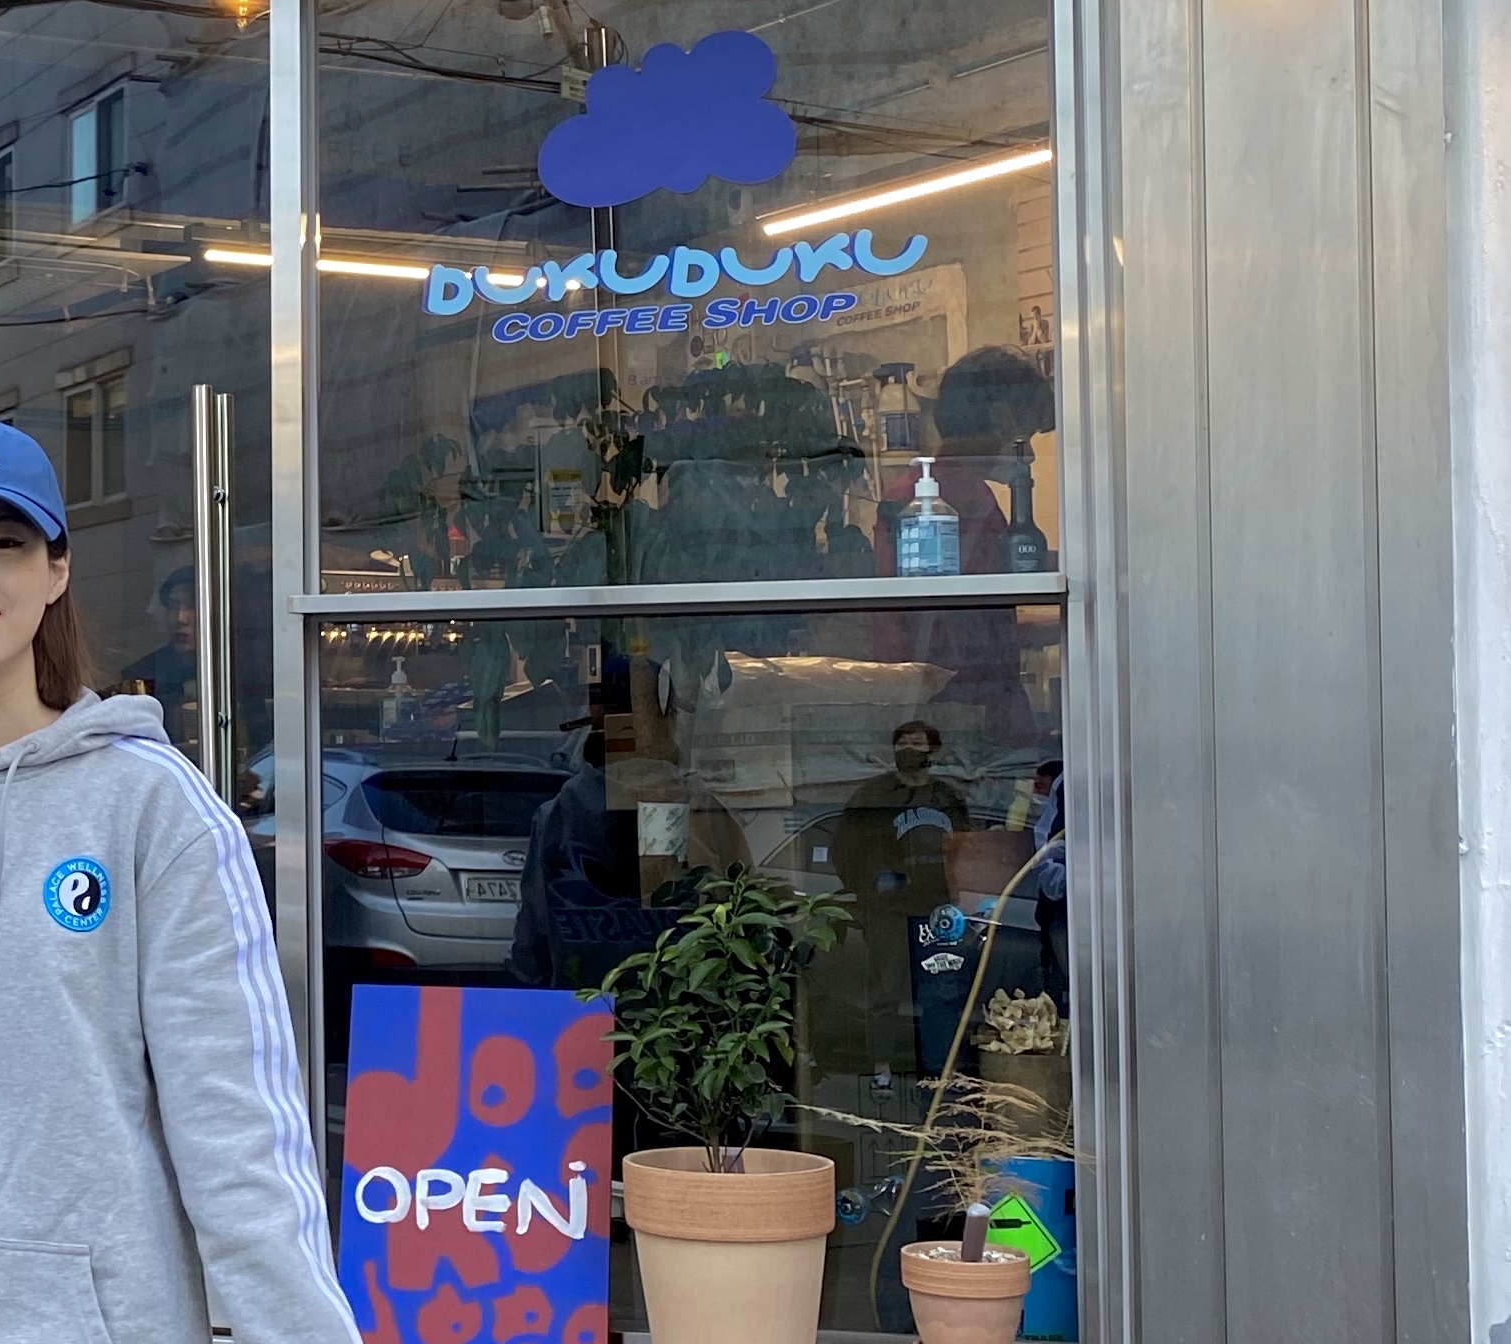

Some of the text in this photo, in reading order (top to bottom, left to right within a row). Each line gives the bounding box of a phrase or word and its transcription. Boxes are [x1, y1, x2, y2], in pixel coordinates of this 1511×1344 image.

[423, 228, 929, 316] DUKUDUKU
[491, 292, 858, 344] COFFEE SHOP
[836, 300, 920, 327] COFFEE SHOP
[48, 861, 108, 927] PALACE WELLNESS CENTER
